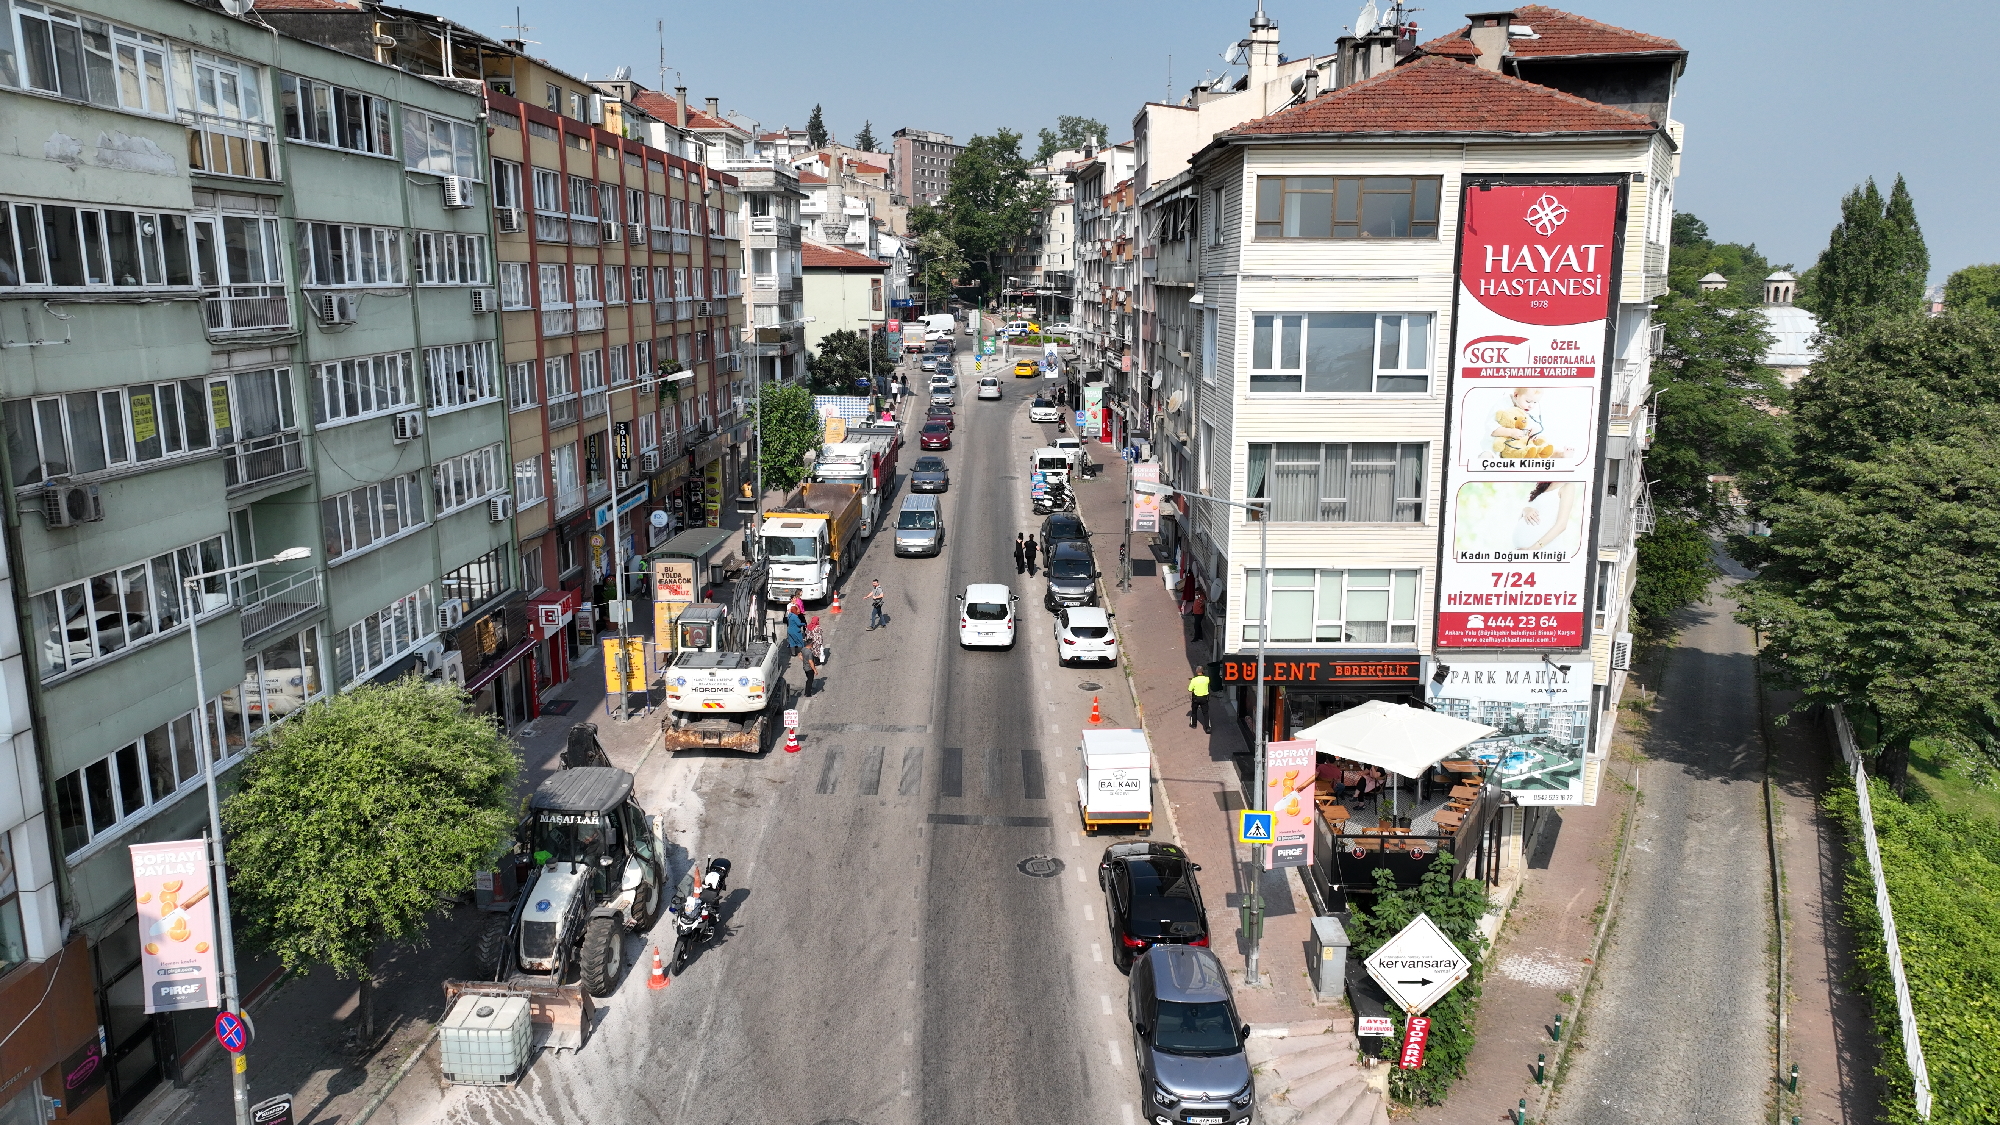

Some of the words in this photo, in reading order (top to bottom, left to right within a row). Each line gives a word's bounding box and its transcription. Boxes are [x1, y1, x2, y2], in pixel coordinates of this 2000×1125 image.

[1484, 244, 1604, 273] HAYAT
[1480, 274, 1602, 296] HASTANESİ
[1530, 300, 1548, 308] 1978
[1550, 339, 1580, 350] ÖZEL
[1469, 347, 1510, 364] SGK
[1480, 367, 1541, 378] ANLAŞMAMIZ
[1543, 367, 1577, 376] VARDIR
[620, 424, 628, 470] SOLARYUM
[1482, 460, 1515, 470] Çocuk
[1519, 460, 1556, 470] Kliniği
[1460, 552, 1490, 560] Kadın
[1494, 552, 1530, 562] Doğum
[1532, 551, 1566, 562] Kliniği
[1491, 572, 1536, 588] 7/24
[1447, 590, 1578, 606] HİZMETİNİZDEYİZ
[1487, 616, 1514, 628] 444
[1518, 616, 1536, 628] 23
[1540, 616, 1558, 628] 64
[1450, 670, 1497, 684] PARK
[1506, 670, 1570, 684] MAHAL
[1268, 748, 1314, 759] SOFRAYI
[1269, 757, 1308, 768] PAYLAŞ
[134, 850, 202, 866] SOFRAYI
[136, 862, 196, 878] PAYLAŞ
[1379, 958, 1459, 970] kervansaray
[1404, 1018, 1427, 1062] OTOPARK
